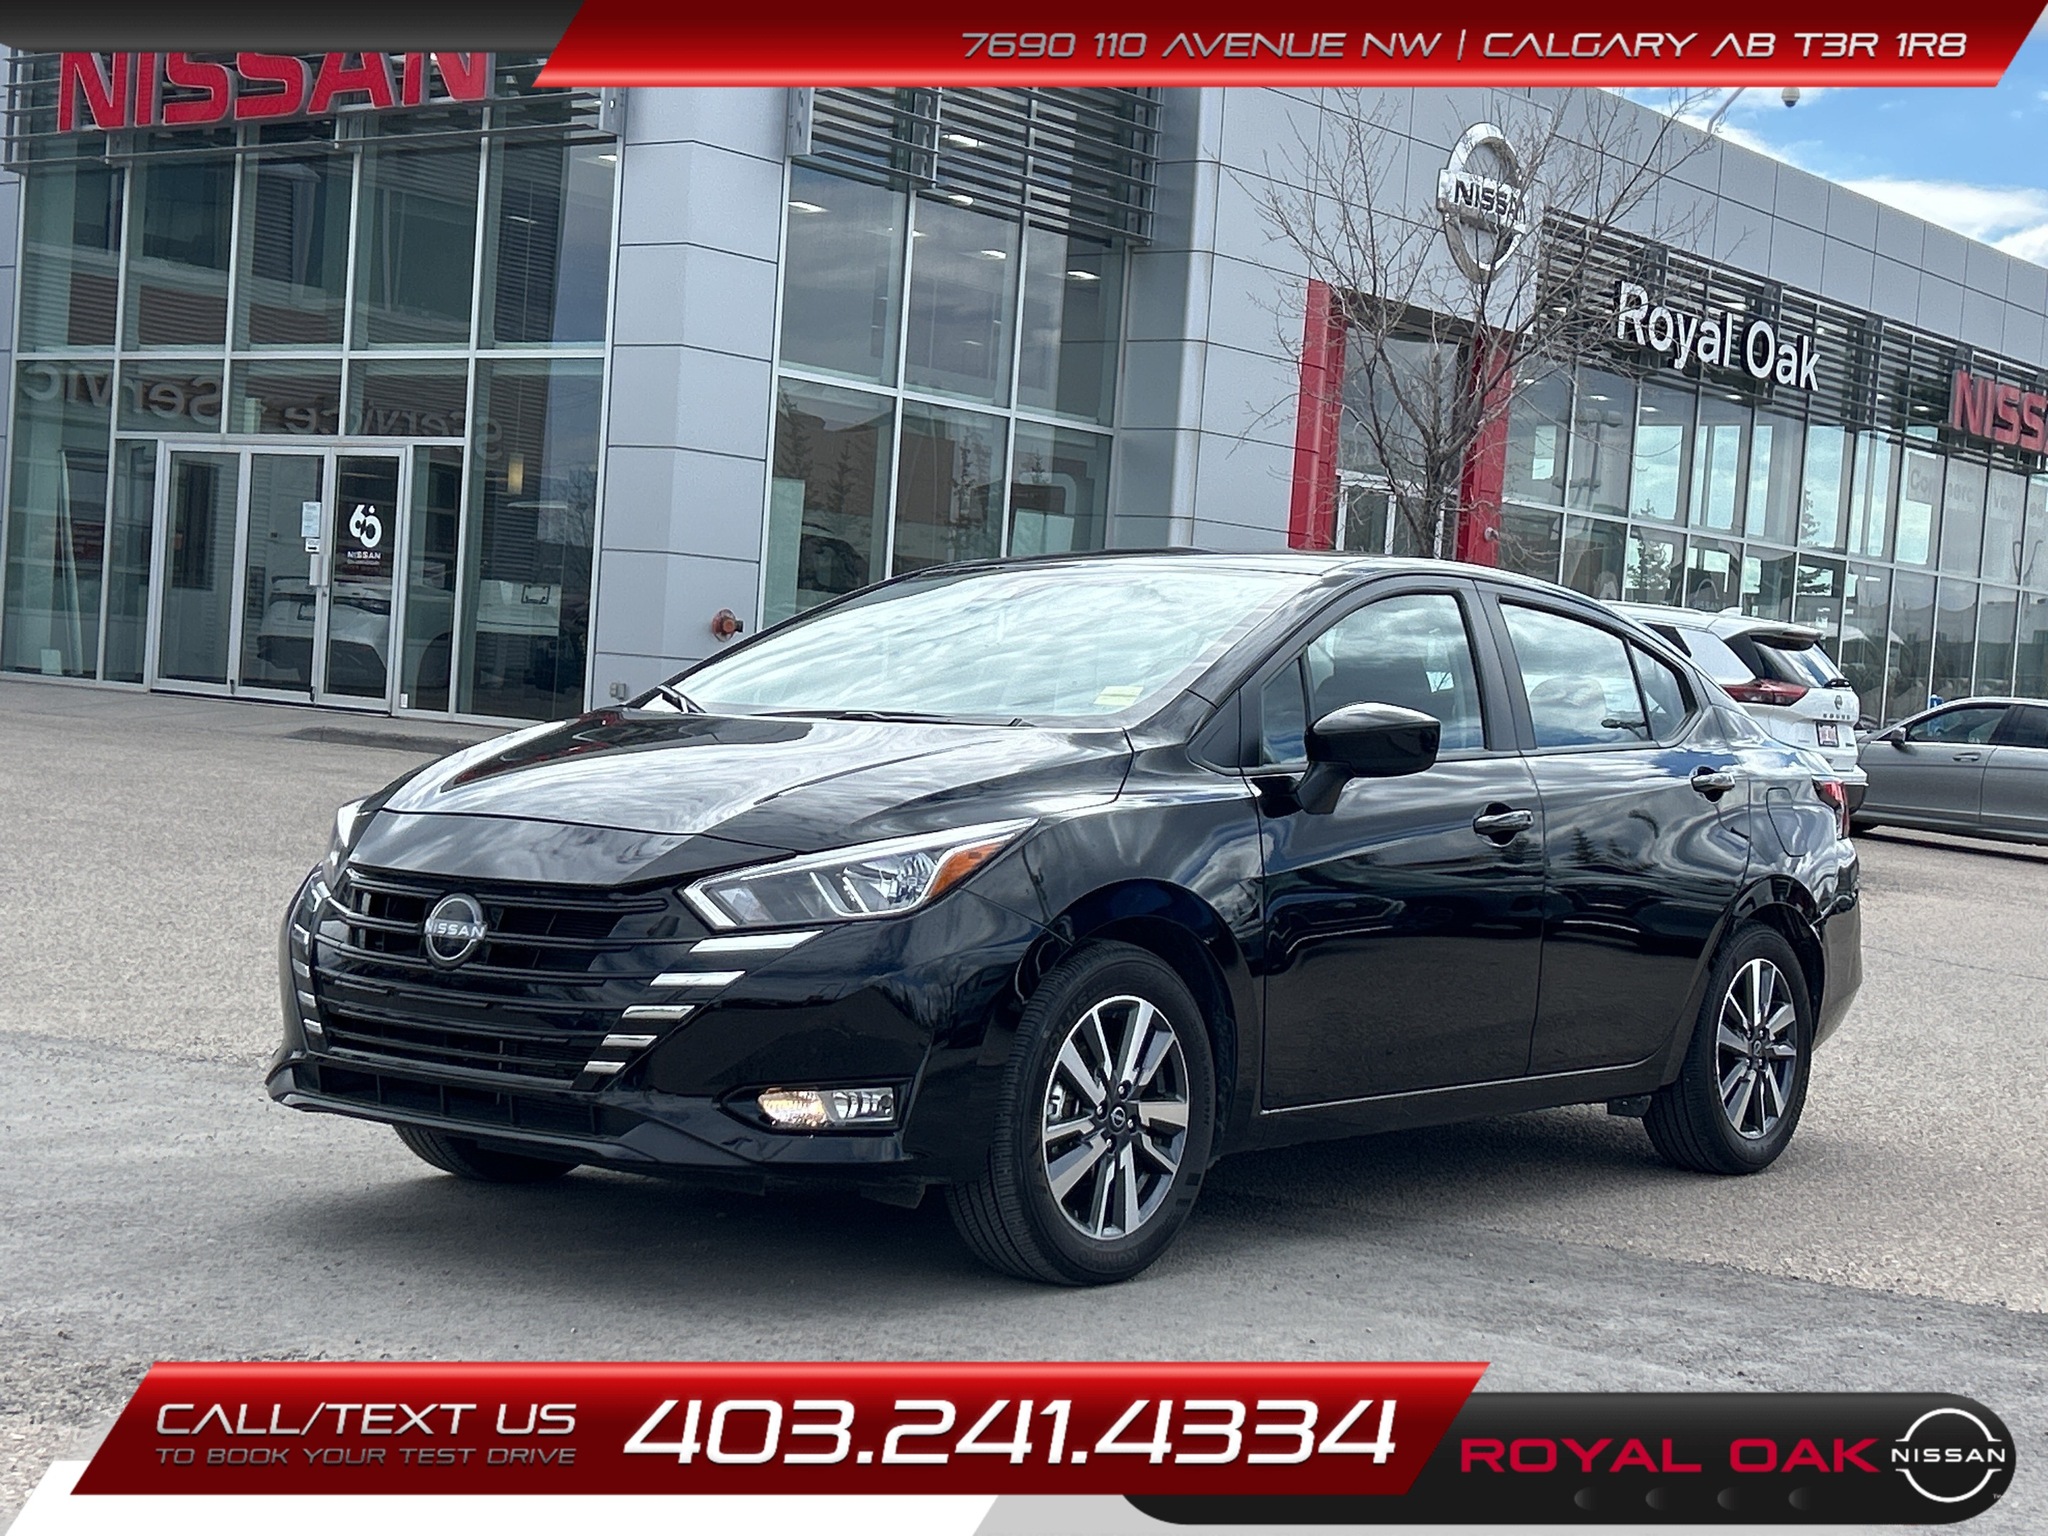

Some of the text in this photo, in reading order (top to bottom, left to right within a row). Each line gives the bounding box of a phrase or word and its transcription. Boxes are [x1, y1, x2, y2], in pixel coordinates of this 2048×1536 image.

[58, 50, 492, 131] NISSAN
[1616, 280, 1820, 391] Royal Oak
[1953, 367, 2048, 455] NISS
[347, 551, 381, 559] NISSAN
[425, 921, 486, 938] NISSAN
